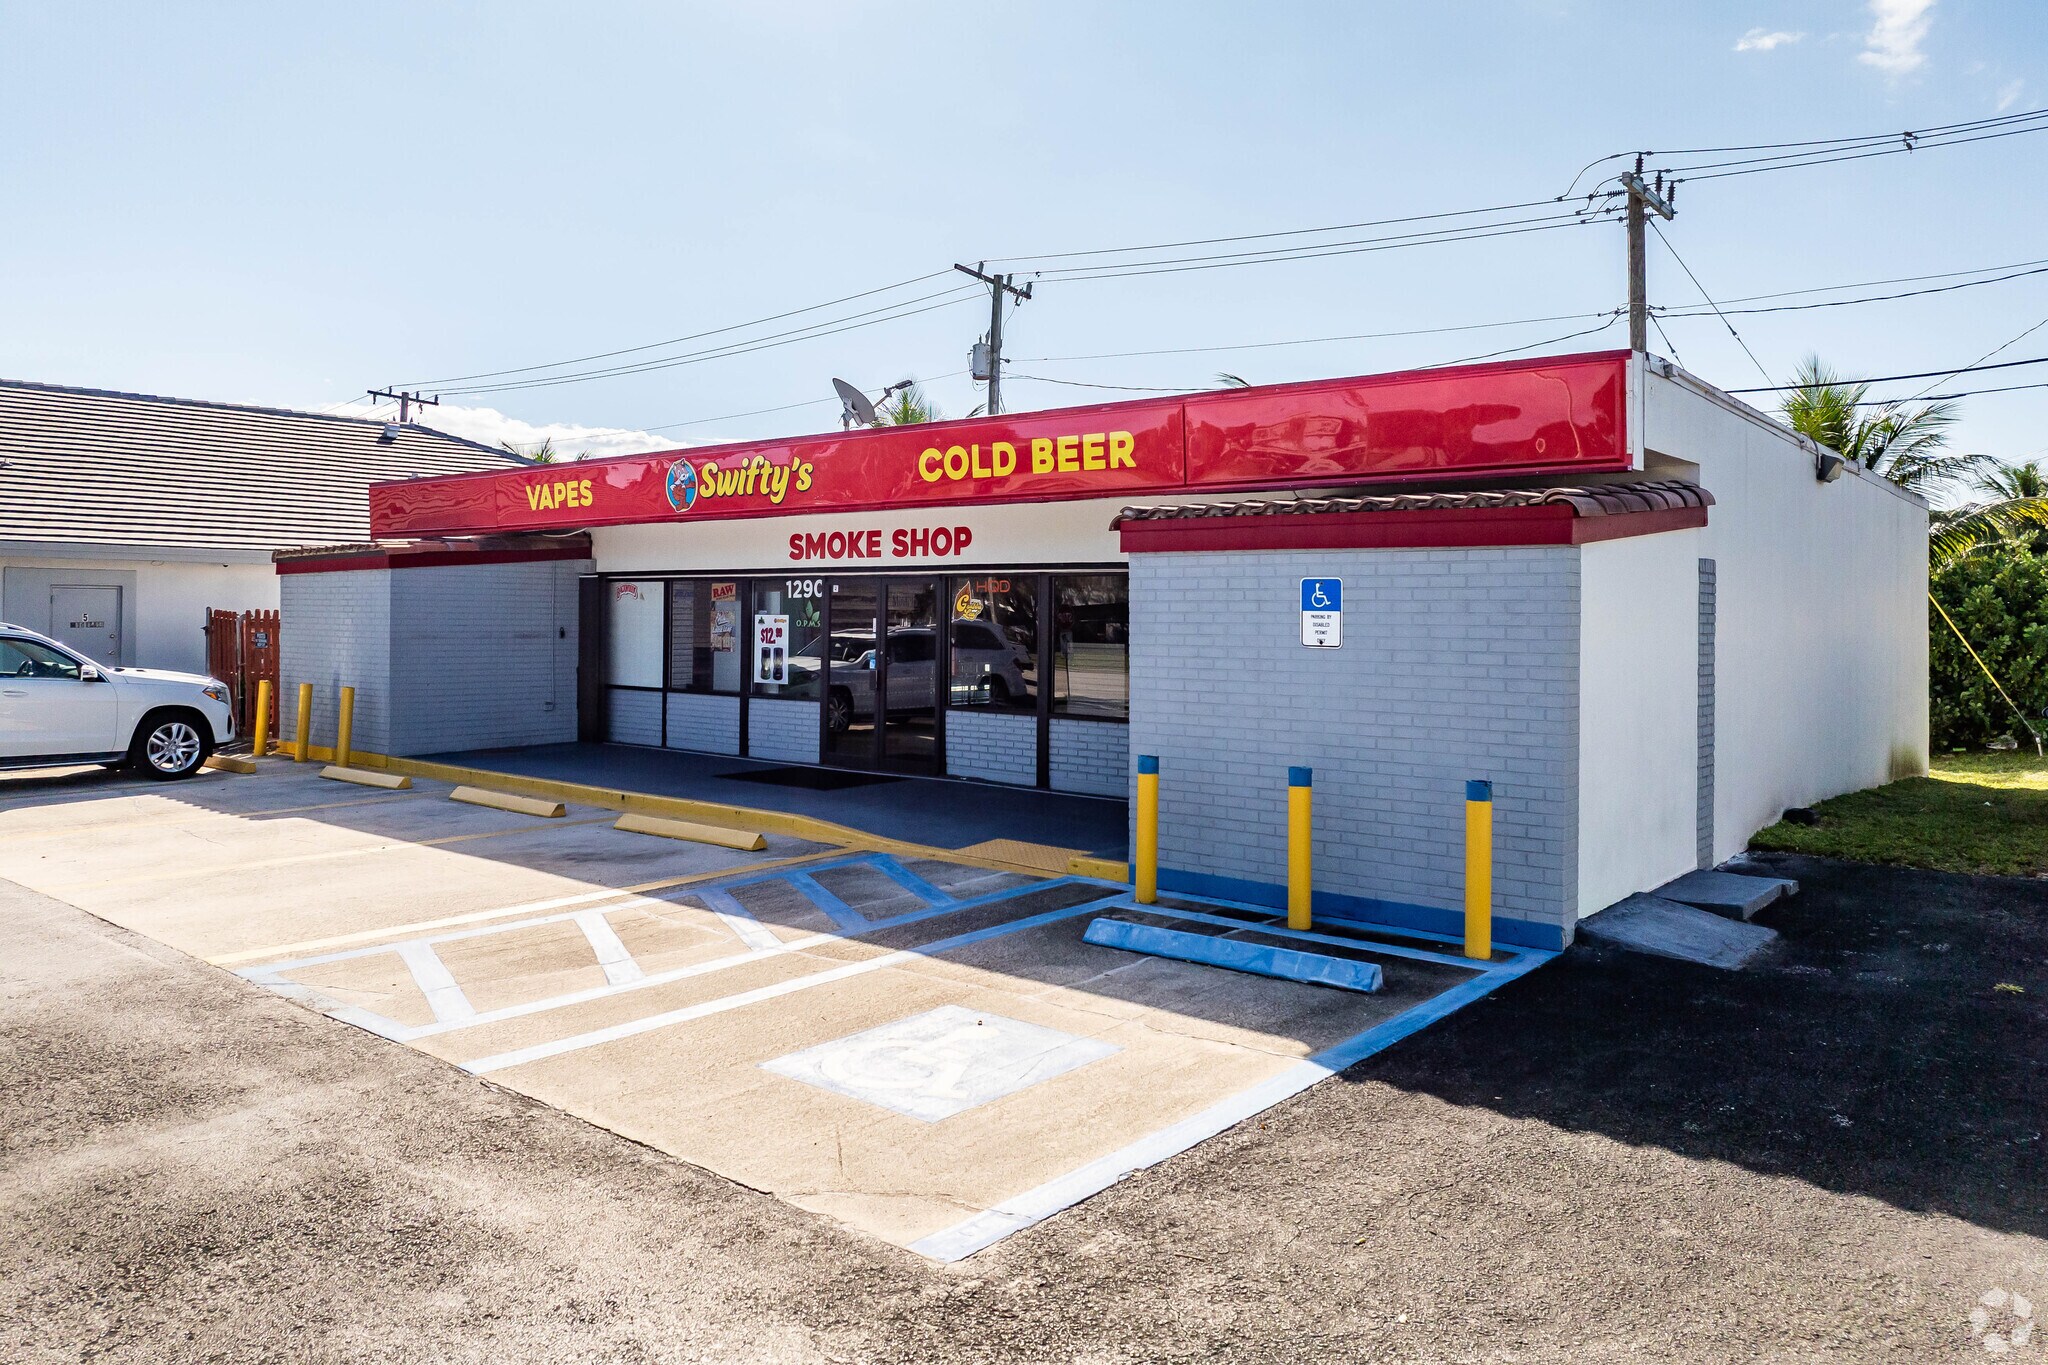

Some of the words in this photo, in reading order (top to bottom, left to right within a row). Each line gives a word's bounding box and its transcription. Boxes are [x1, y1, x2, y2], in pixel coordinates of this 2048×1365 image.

[918, 441, 1017, 482] COLD
[1031, 431, 1137, 474] BEER
[526, 479, 593, 511] VAPES
[698, 455, 814, 504] Swifty's
[789, 530, 882, 561] SMOKE
[891, 526, 973, 558] SHOP
[712, 584, 735, 599] RAW
[976, 580, 1011, 593] HQD
[83, 613, 88, 621] 5
